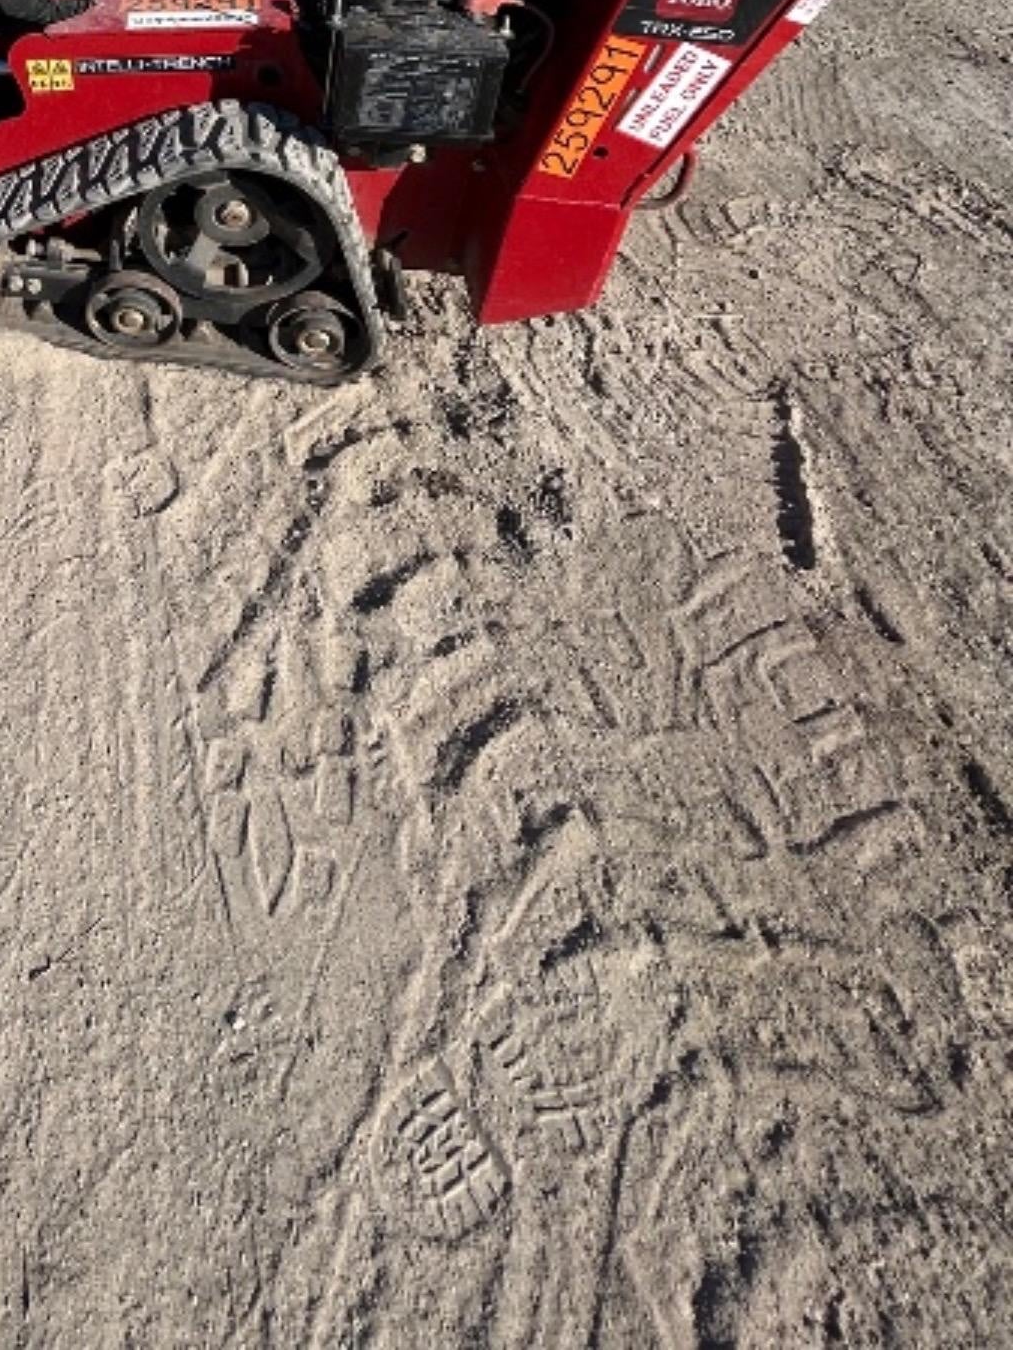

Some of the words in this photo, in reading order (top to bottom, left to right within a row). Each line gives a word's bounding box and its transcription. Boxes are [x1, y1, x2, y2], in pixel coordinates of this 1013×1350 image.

[541, 44, 640, 175] 259291
[629, 49, 700, 133] UNLEADED
[649, 105, 686, 141] FUEL
[680, 59, 720, 101] ONLY
